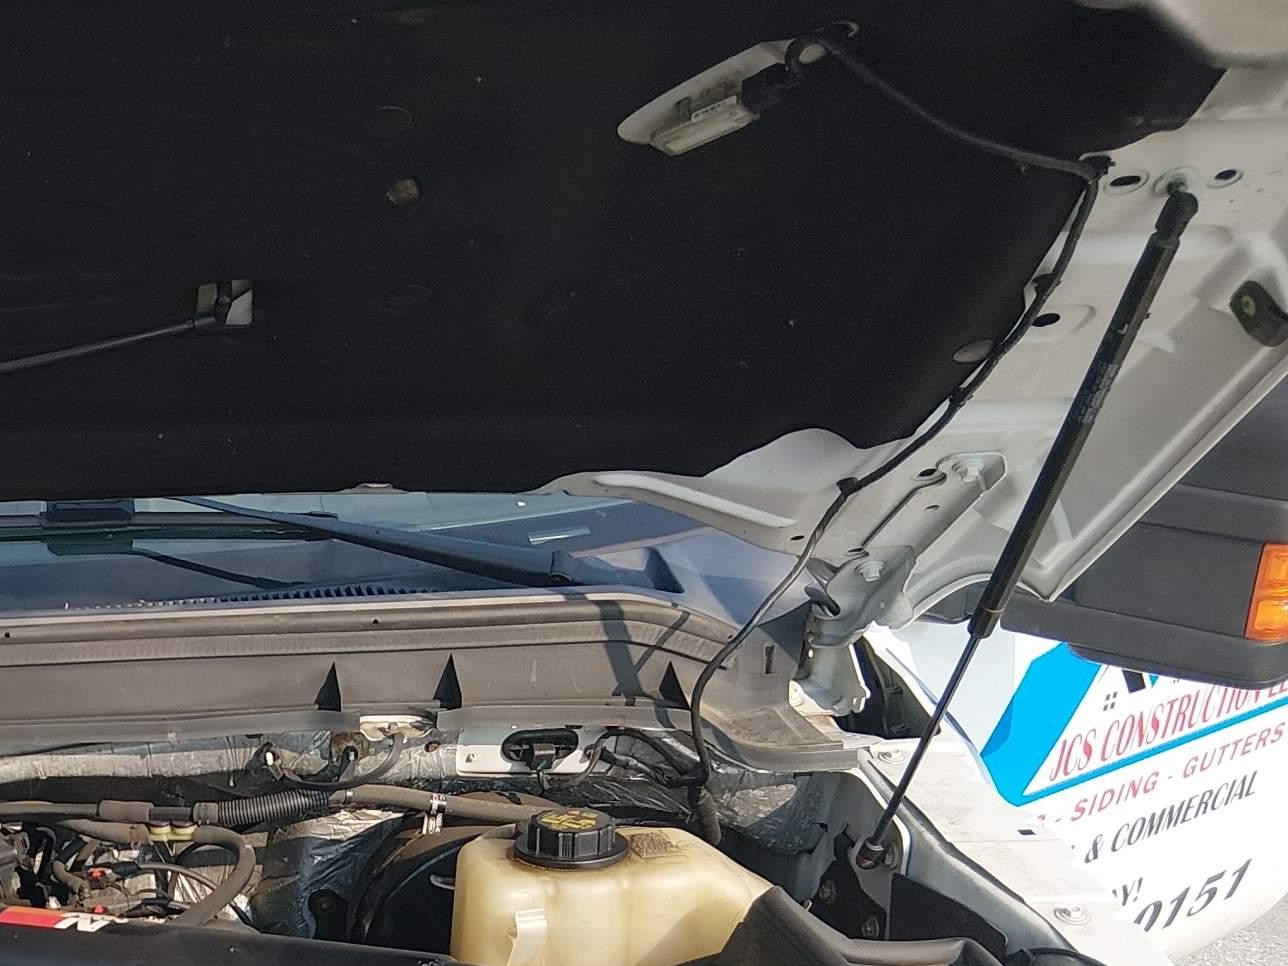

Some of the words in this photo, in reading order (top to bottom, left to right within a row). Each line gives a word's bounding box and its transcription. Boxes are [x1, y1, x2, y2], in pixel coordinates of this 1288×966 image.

[1049, 728, 1098, 782] JCS
[1070, 770, 1159, 823] SIDING
[1182, 722, 1287, 780] GUTTERS
[1084, 833, 1104, 864] &
[1111, 770, 1259, 853] COMMERCIAL
